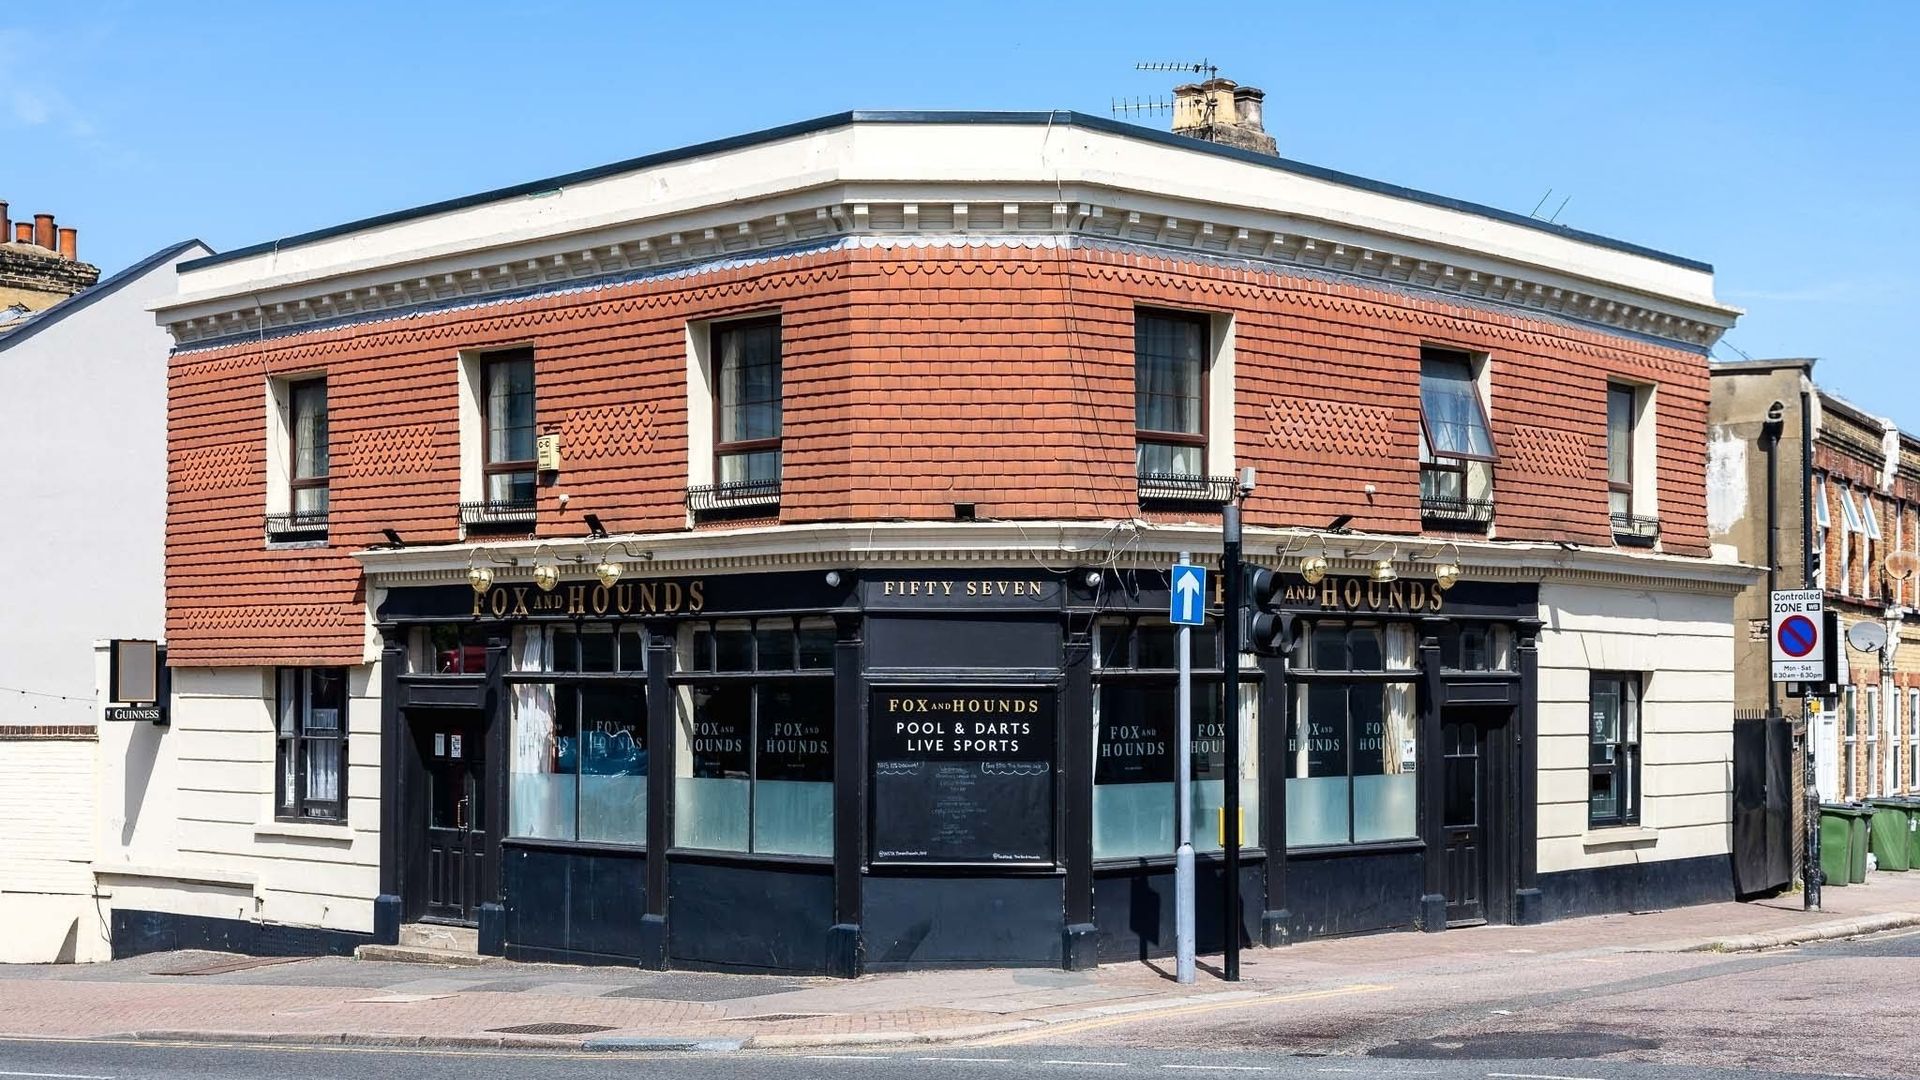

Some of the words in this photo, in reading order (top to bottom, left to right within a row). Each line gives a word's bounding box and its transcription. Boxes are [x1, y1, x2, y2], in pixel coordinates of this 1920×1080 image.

[884, 581, 953, 595] FIFTY
[966, 581, 1042, 596] SEVEN
[1286, 585, 1316, 600] AND
[1320, 577, 1443, 611] HOUNDS
[472, 587, 529, 616] FOX
[534, 596, 562, 609] AND
[568, 580, 704, 615] HOUNDS
[1773, 592, 1820, 601] Controlled
[1774, 602, 1802, 612] ZONE
[889, 699, 928, 712] FOX
[952, 699, 1039, 713] HOUNDS
[115, 709, 159, 719] GUINNESS
[693, 722, 718, 735] FOX
[774, 723, 802, 736] FOX
[805, 726, 820, 734] AND
[896, 722, 945, 735] POOL
[954, 723, 965, 735] &
[975, 722, 1031, 735] DARTS
[1110, 725, 1139, 739] FOX
[1198, 723, 1224, 736] FOX
[686, 738, 742, 752] OUNDS
[767, 739, 828, 754] HOUNDS
[907, 740, 944, 751] LIVE
[953, 739, 1019, 751] SPORTS
[1102, 742, 1165, 757] HOUNDS
